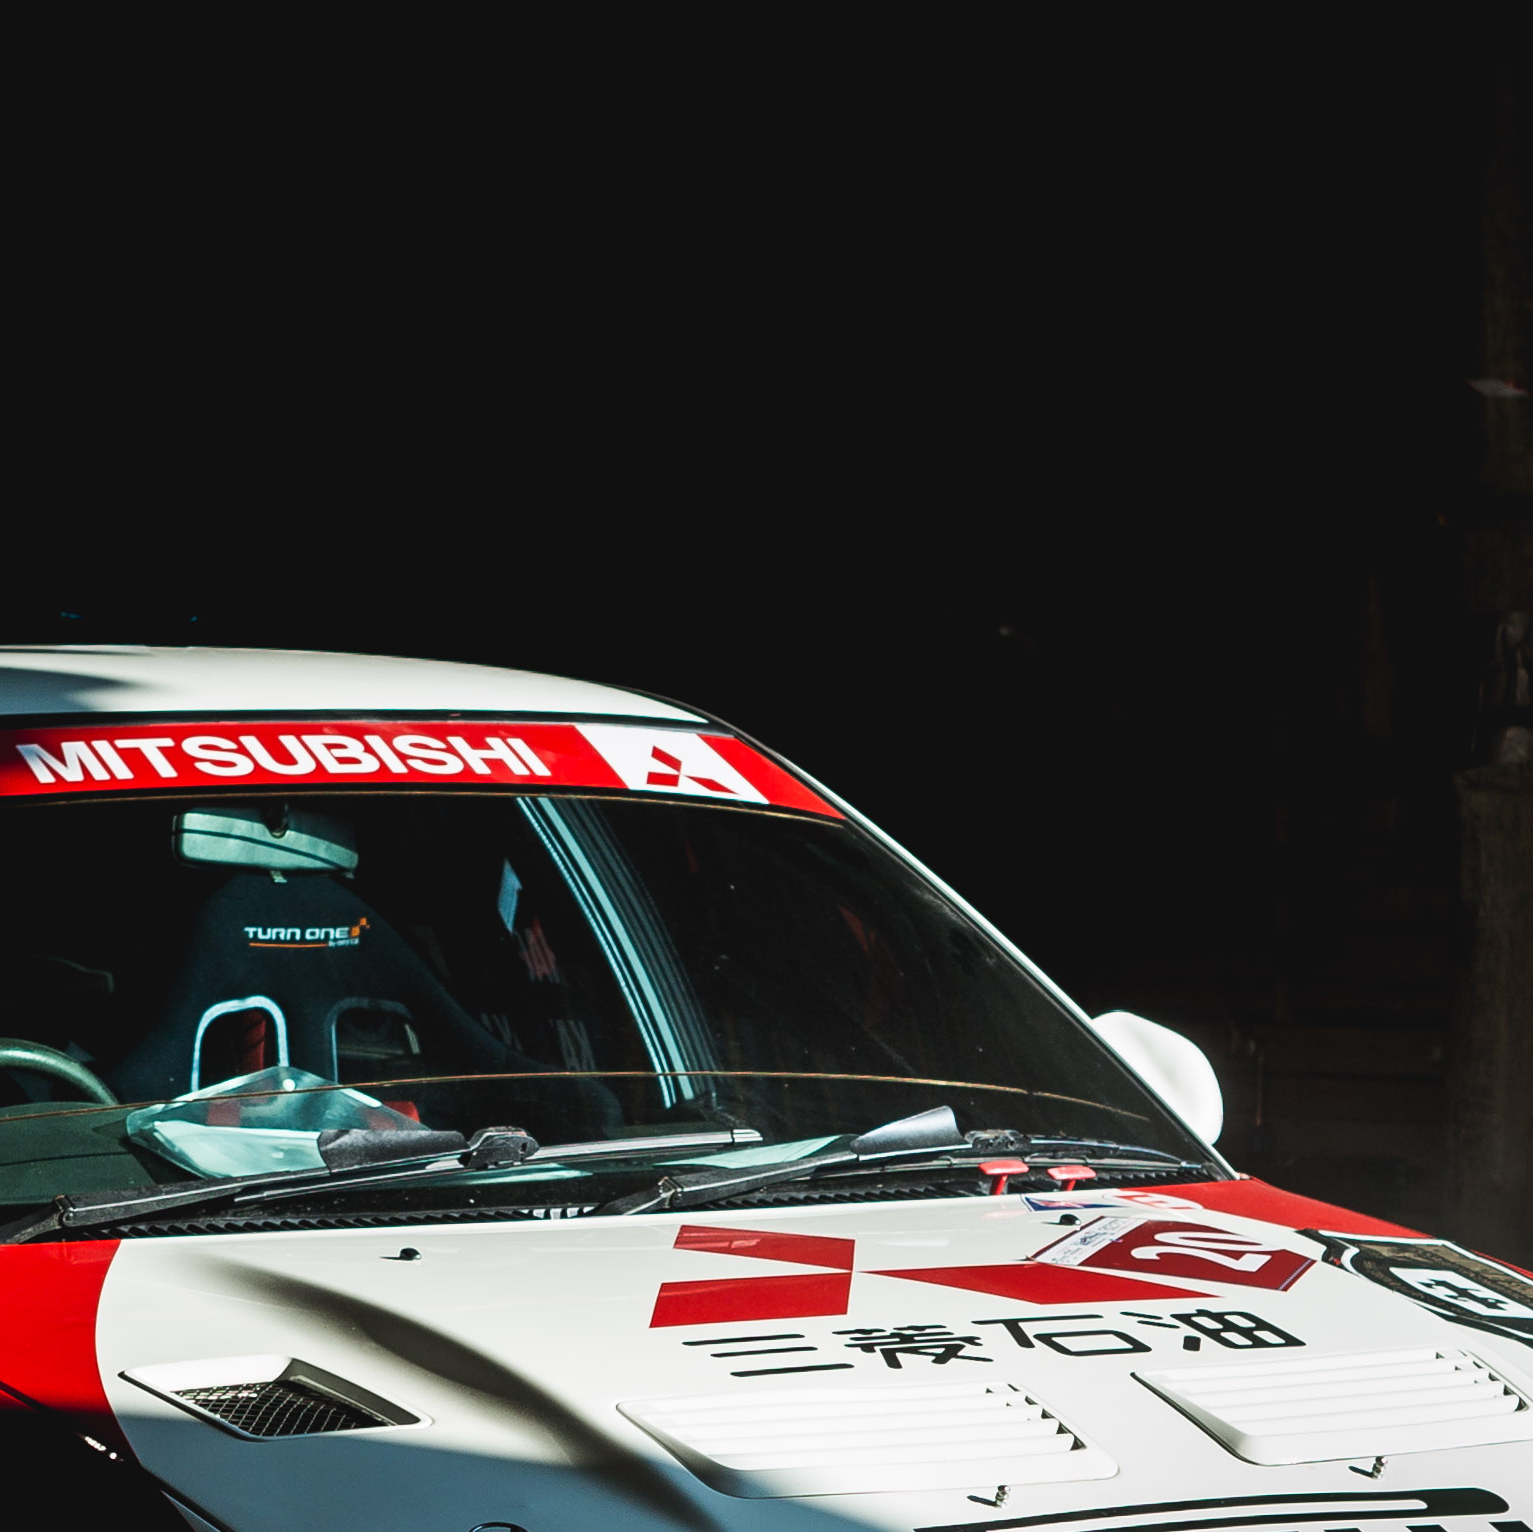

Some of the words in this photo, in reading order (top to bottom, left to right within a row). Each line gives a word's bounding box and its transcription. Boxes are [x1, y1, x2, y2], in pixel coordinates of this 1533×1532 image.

[16, 734, 552, 784] MITSUBISHI
[244, 927, 300, 940] TURN
[305, 927, 349, 940] ONE
[1130, 1231, 1272, 1272] 20
[682, 1309, 1306, 1377] 三菱石油
